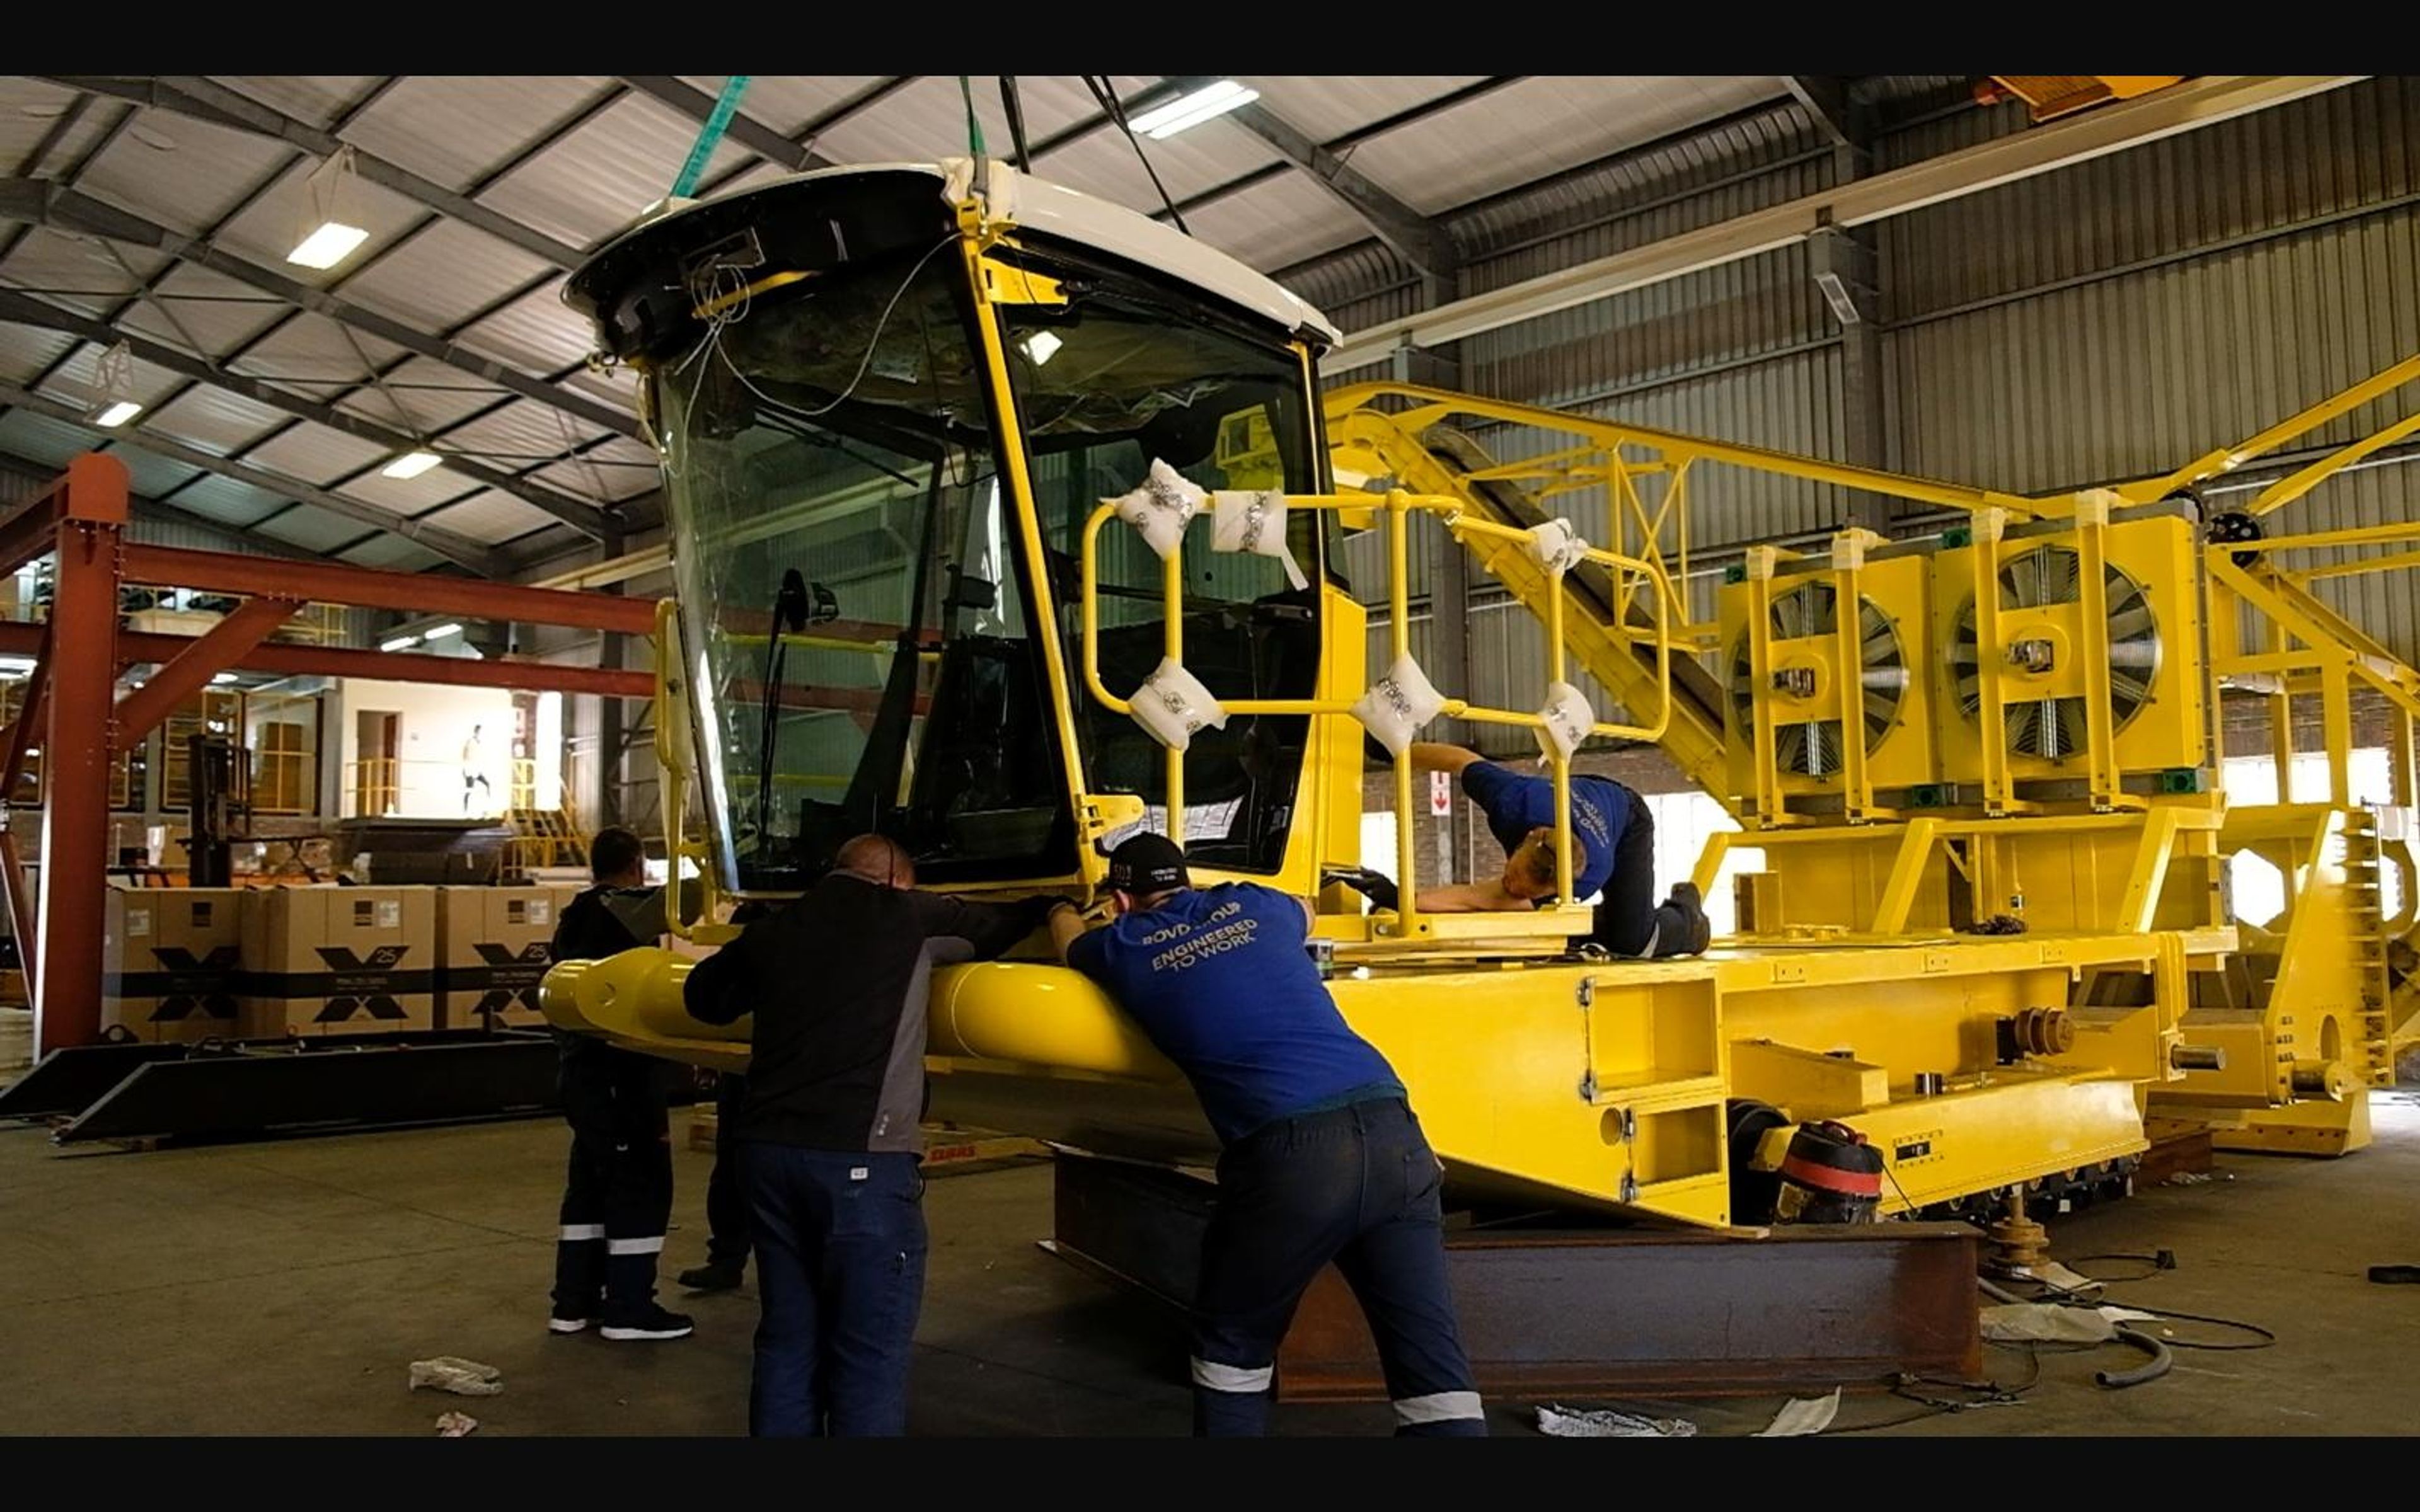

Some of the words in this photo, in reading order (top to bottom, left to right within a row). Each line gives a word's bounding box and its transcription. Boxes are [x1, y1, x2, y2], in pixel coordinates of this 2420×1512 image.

[376, 949, 396, 963] 25
[1152, 919, 1258, 971] ENGINEERED
[1170, 954, 1196, 972] TO
[1198, 932, 1257, 959] WORK
